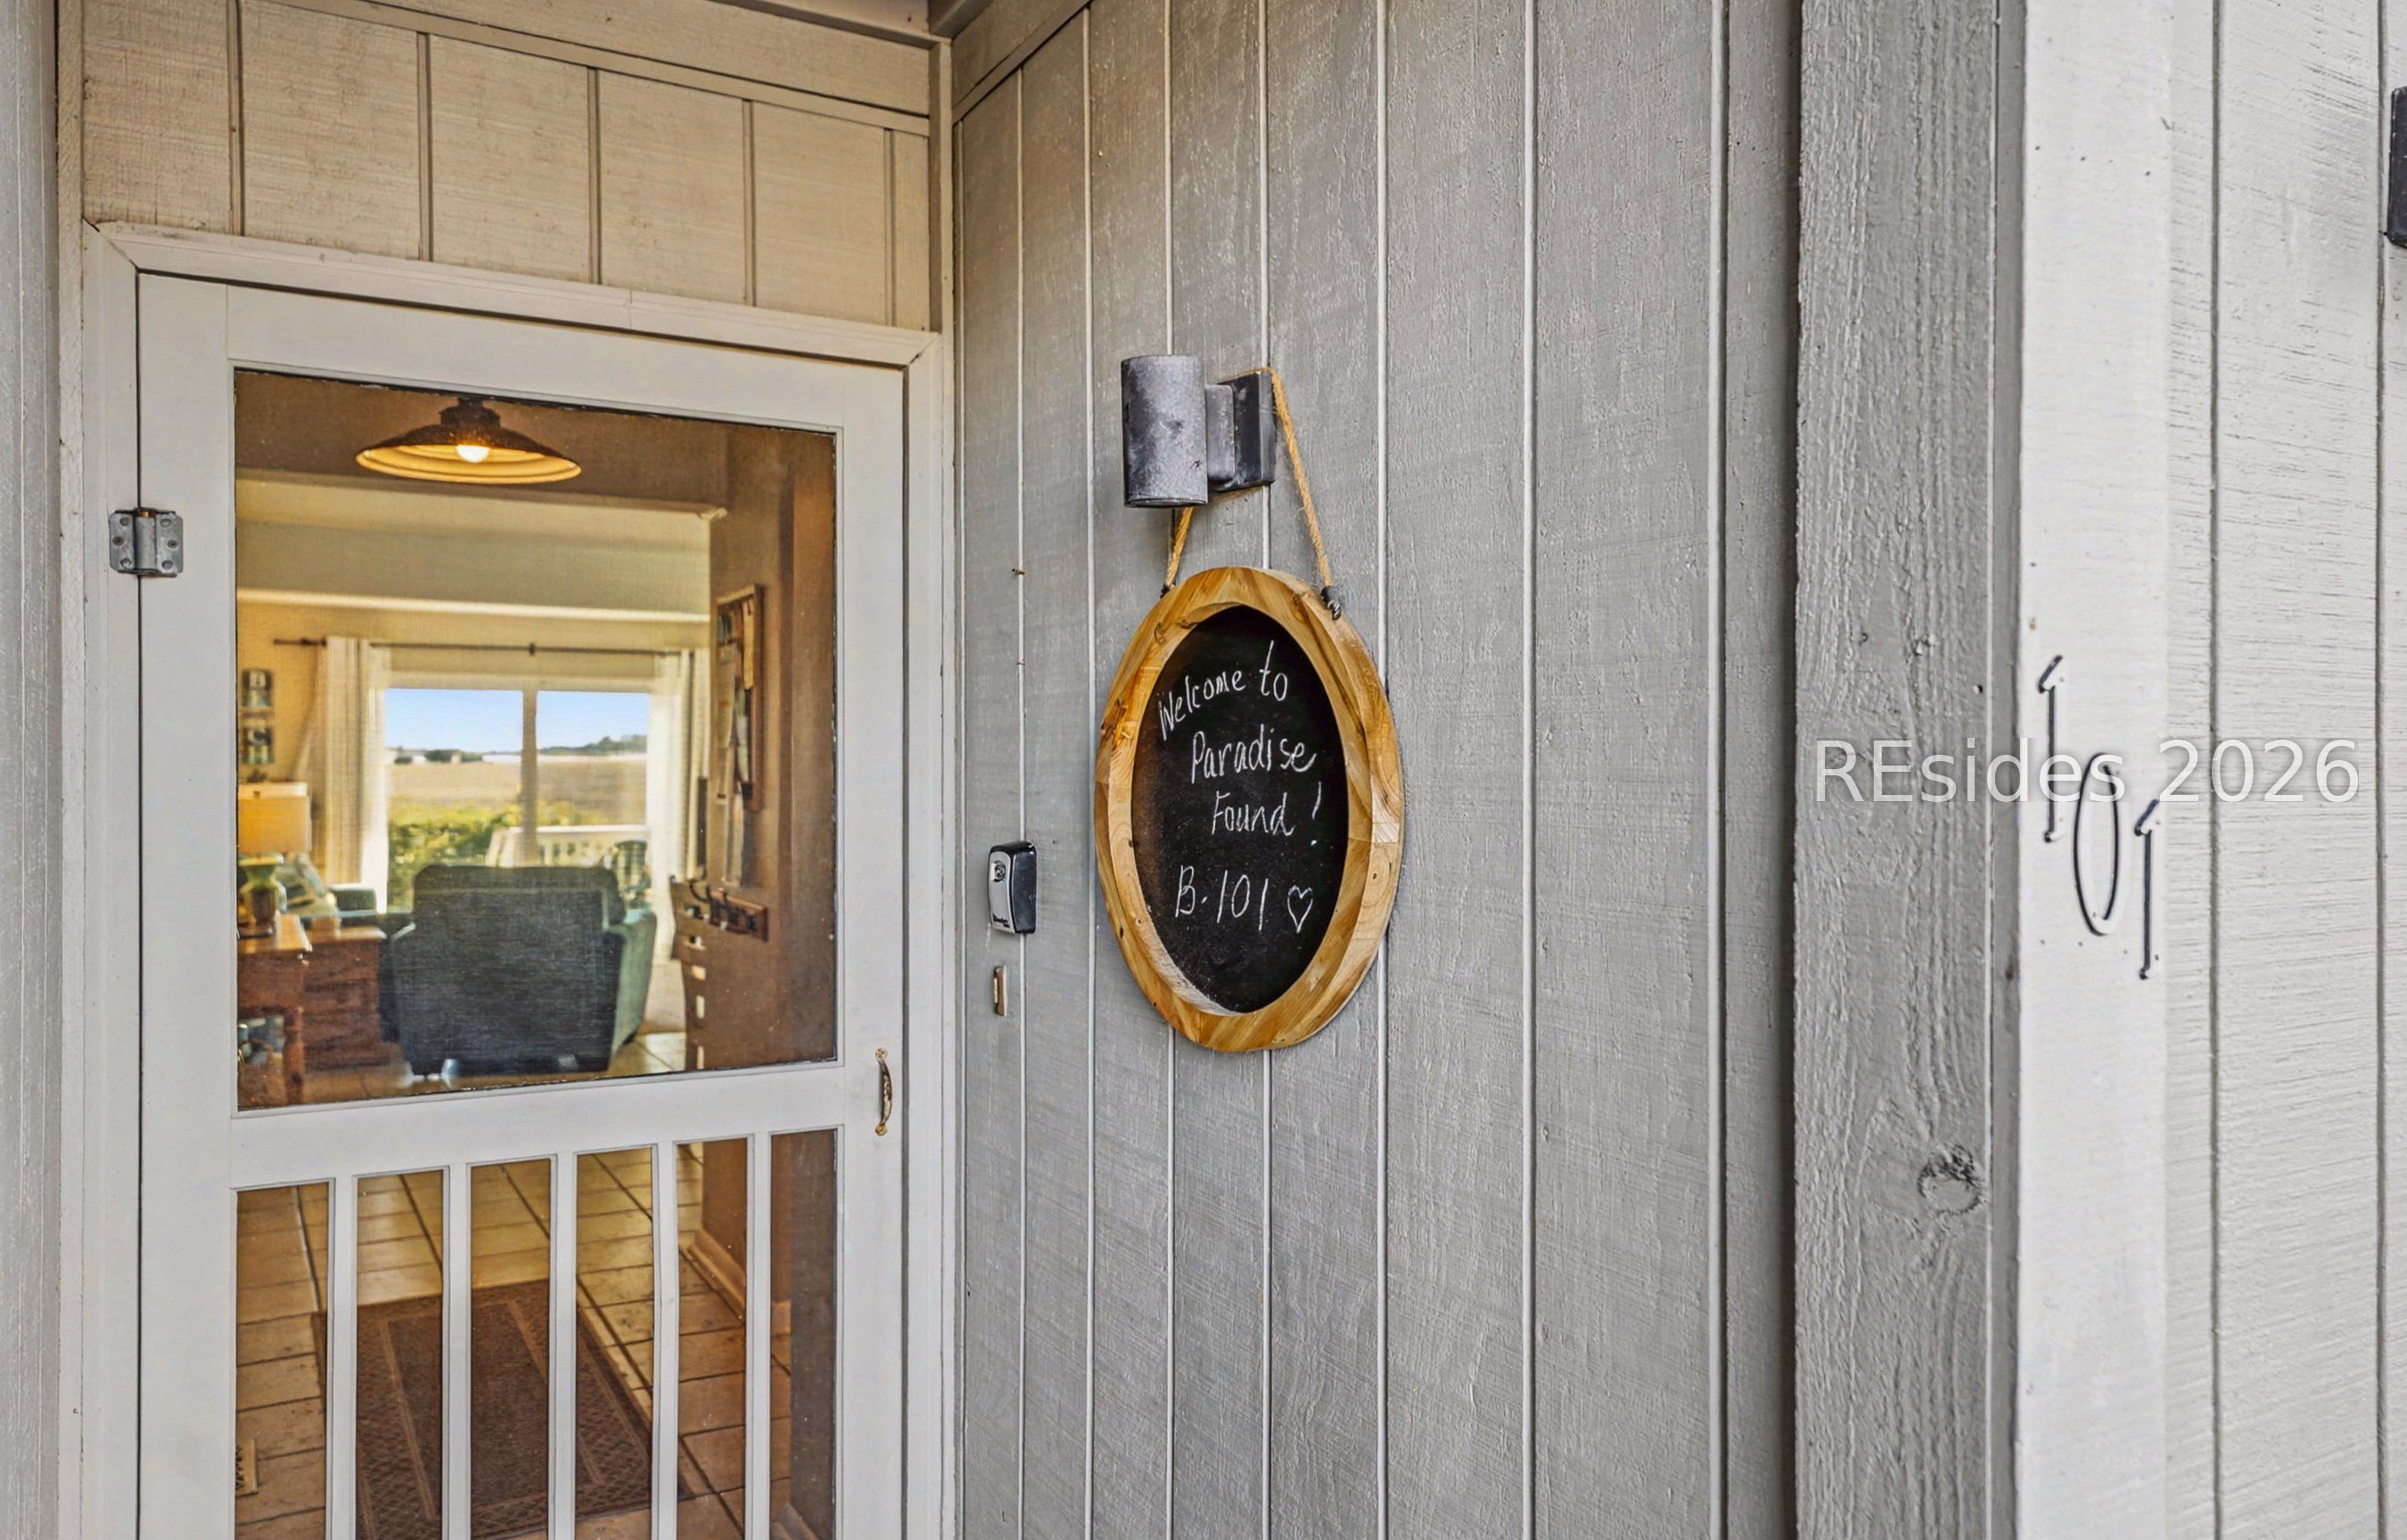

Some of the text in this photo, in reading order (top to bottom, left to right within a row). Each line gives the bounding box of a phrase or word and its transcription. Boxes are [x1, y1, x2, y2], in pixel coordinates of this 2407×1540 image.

[1159, 640, 1288, 741] Welcome to
[1191, 723, 1318, 784] Paradise
[2037, 654, 2159, 980] 101
